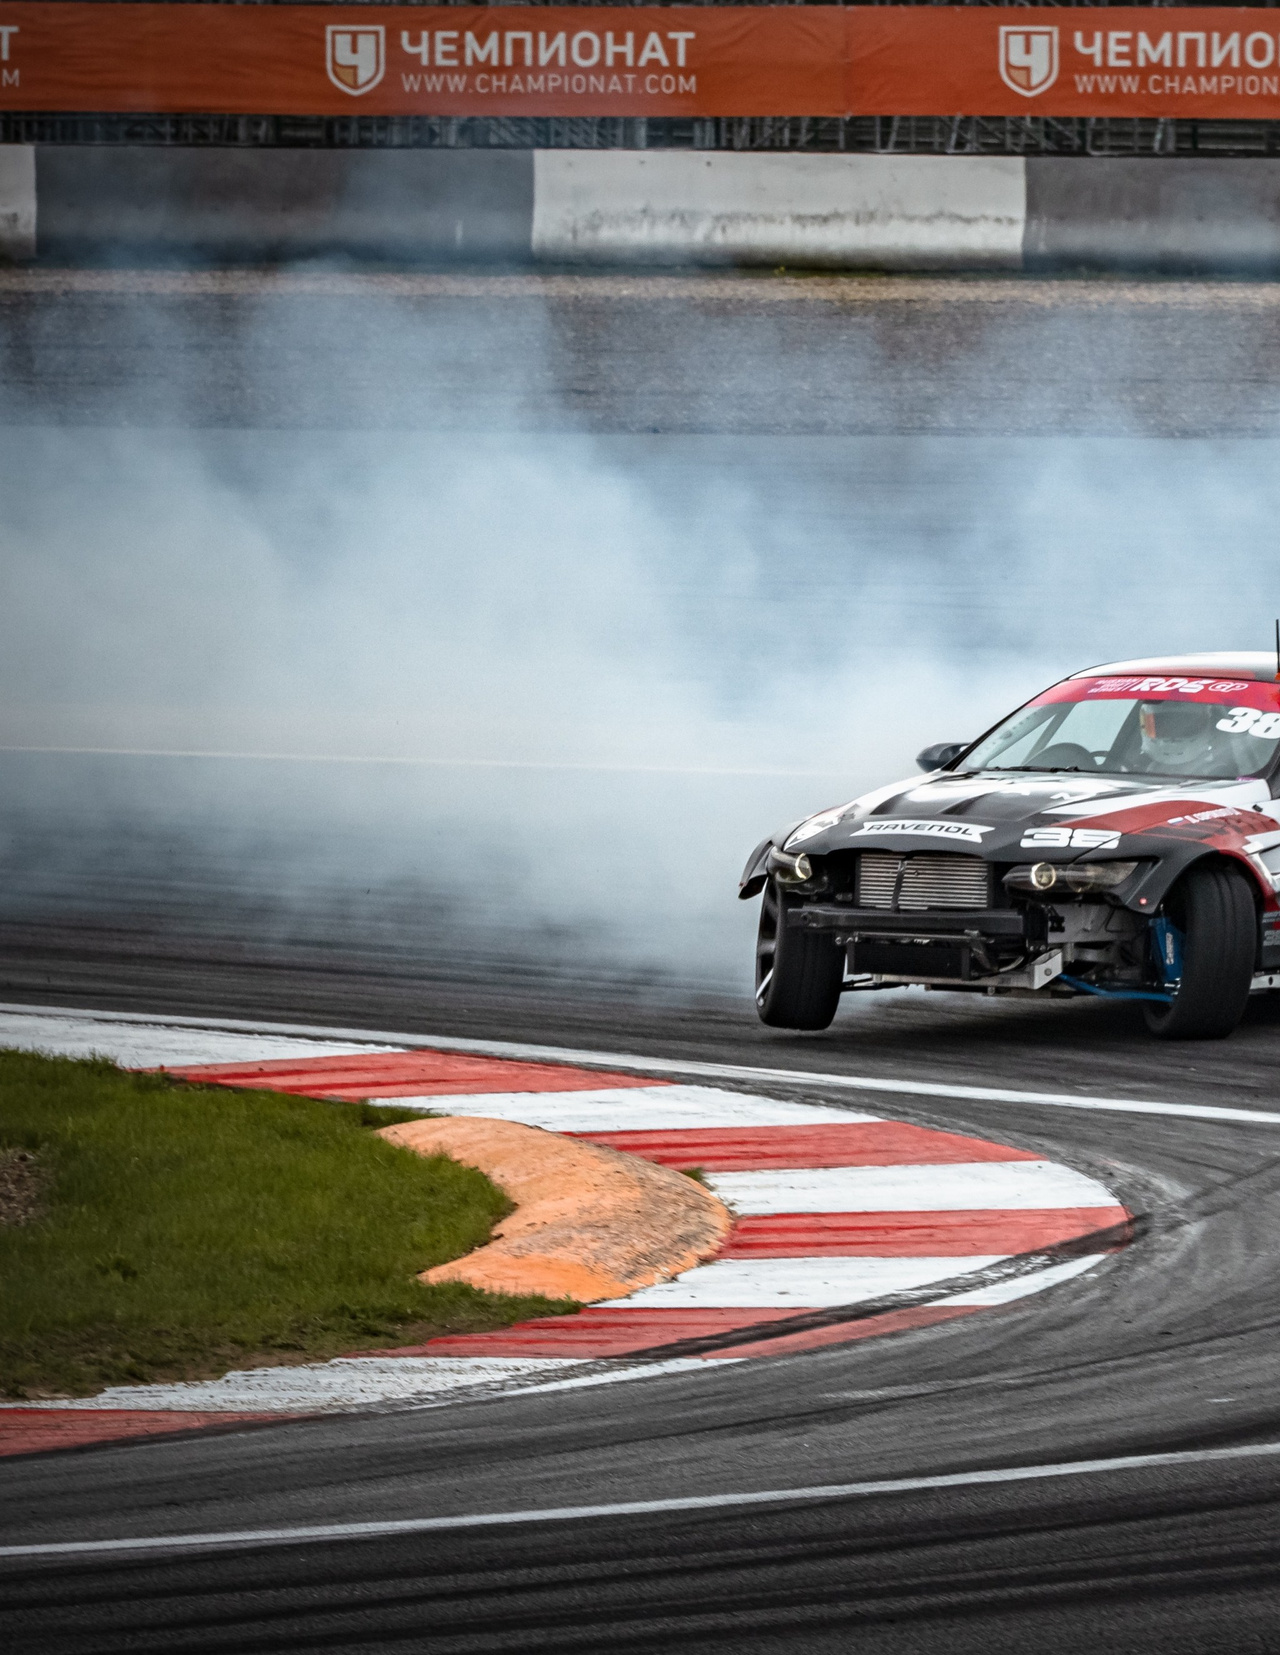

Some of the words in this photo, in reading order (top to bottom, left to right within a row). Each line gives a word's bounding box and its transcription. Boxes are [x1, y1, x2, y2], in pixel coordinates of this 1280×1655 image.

[401, 31, 696, 67] ЧЕМПИОНАТ
[401, 73, 697, 94] WWW.CHAMPIONAT.COM
[1129, 677, 1215, 694] RDS
[866, 821, 973, 837] RAVENOL
[1020, 826, 1122, 850] 38
